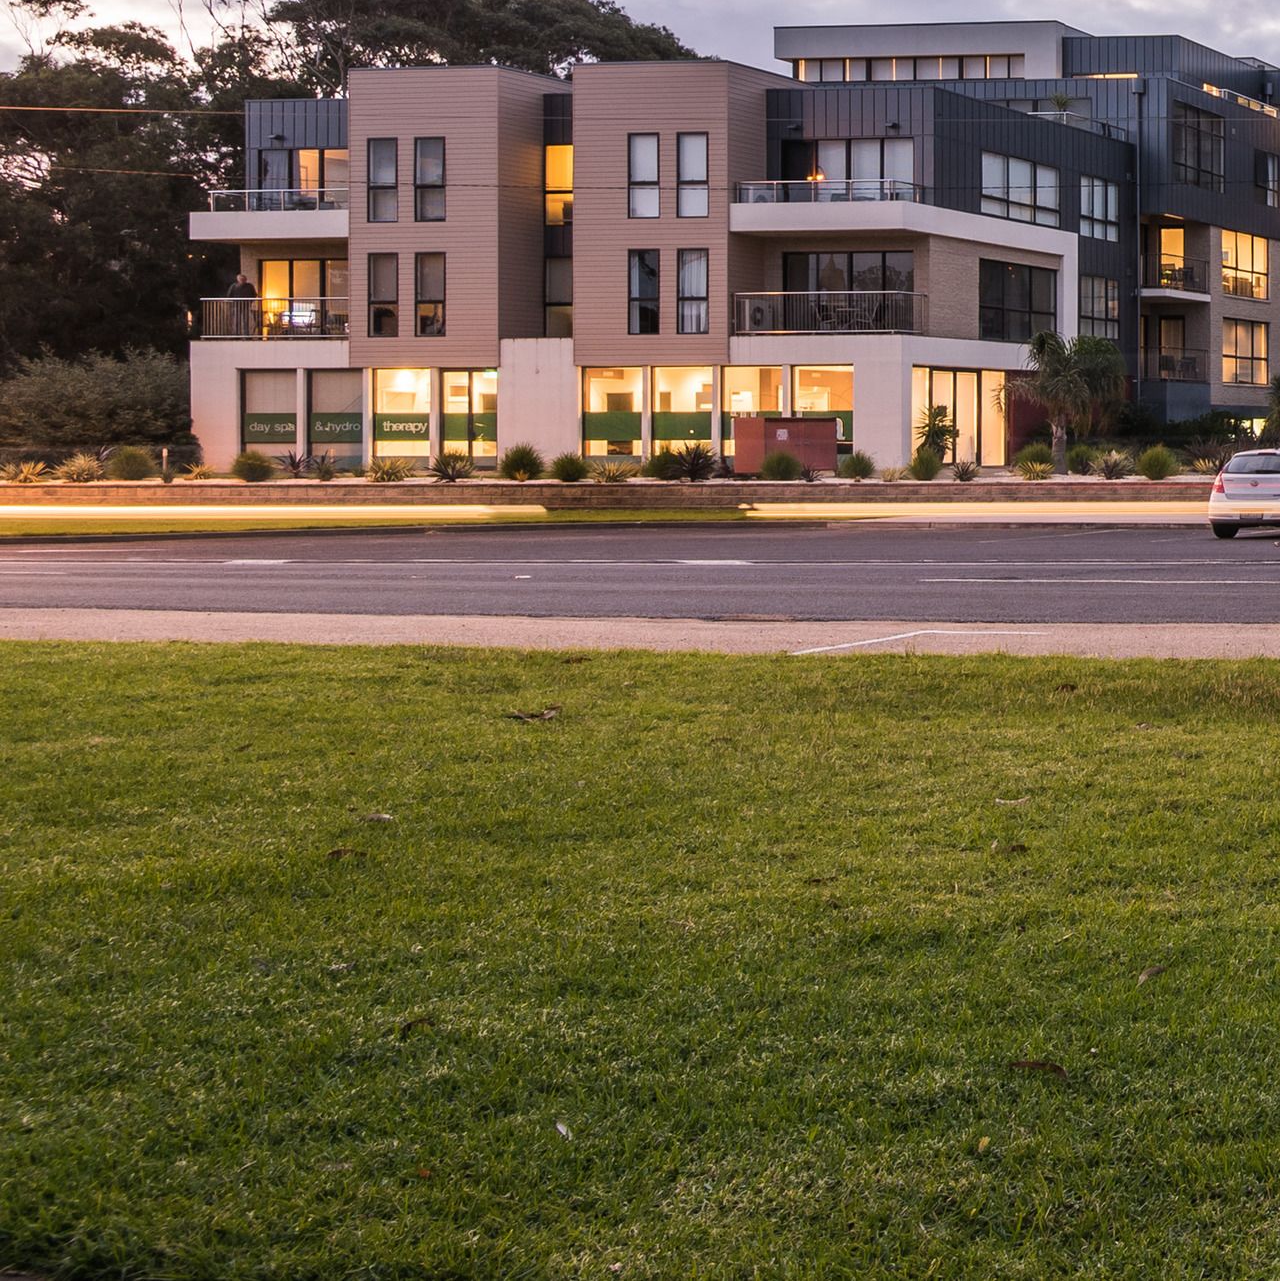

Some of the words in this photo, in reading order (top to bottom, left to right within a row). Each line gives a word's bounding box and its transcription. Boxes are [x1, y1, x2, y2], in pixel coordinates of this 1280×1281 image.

[250, 421, 270, 433] day
[274, 423, 295, 433] spa
[315, 421, 323, 431] &
[328, 421, 361, 433] hydro
[382, 421, 428, 433] therapy
